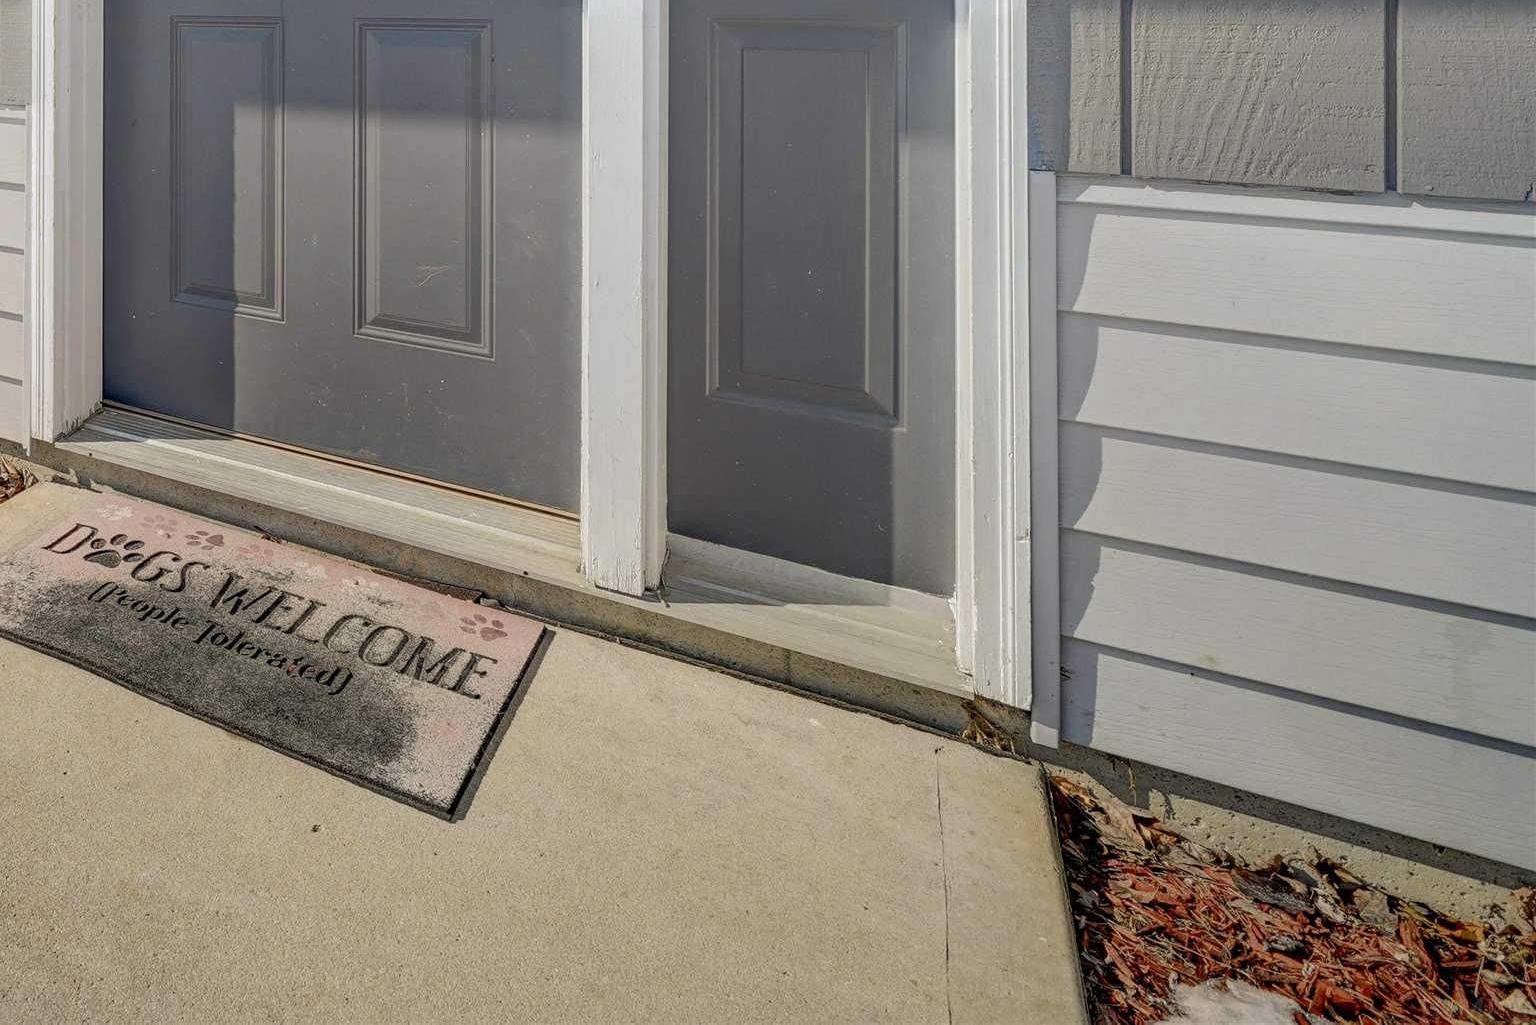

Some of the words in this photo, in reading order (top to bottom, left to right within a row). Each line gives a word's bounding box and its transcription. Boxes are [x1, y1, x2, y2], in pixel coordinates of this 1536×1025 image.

[87, 581, 191, 629] (People
[192, 620, 354, 696] Tolerated)
[209, 572, 498, 700] WELCOME
